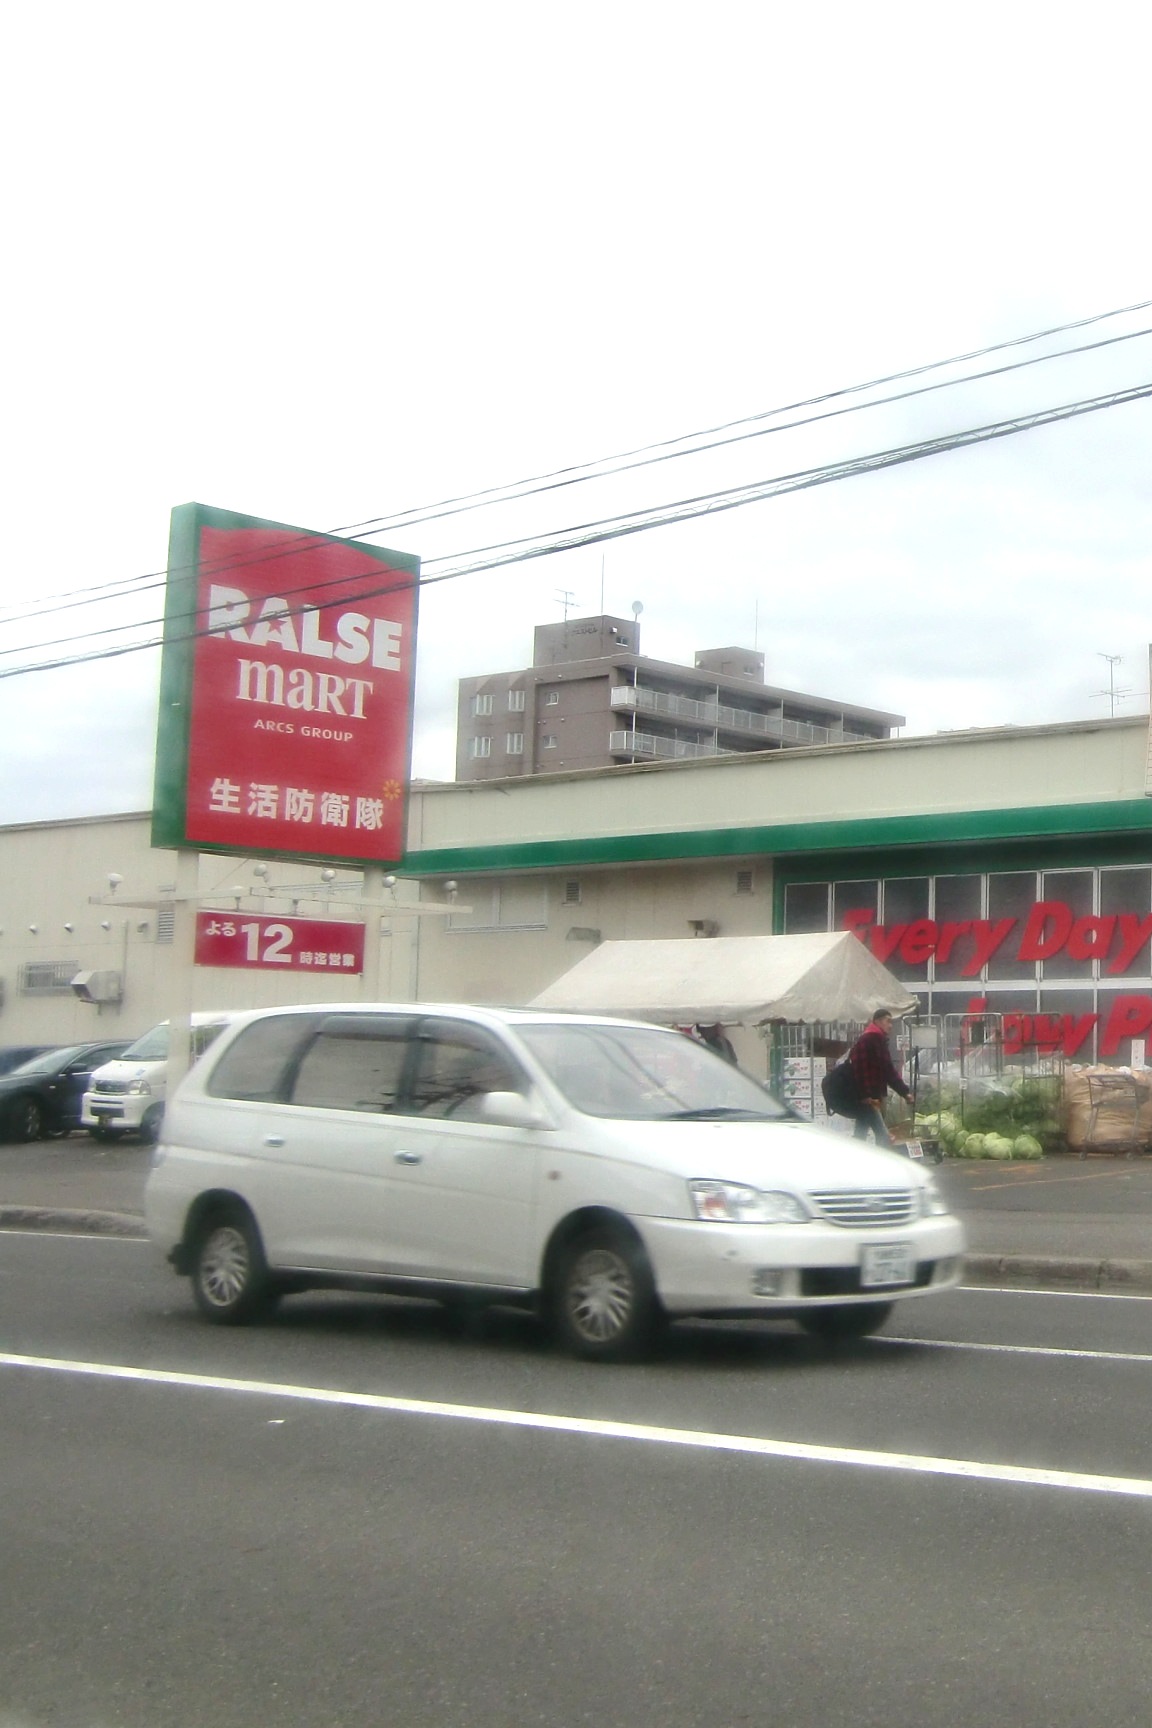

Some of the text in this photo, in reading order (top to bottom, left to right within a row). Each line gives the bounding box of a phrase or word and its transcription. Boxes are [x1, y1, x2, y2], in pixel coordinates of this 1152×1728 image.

[207, 584, 403, 672] RALSE
[254, 719, 353, 742] ARCS GROUP
[208, 777, 384, 830] 生活防衛隊
[205, 920, 237, 937] よる
[241, 922, 294, 963] 12
